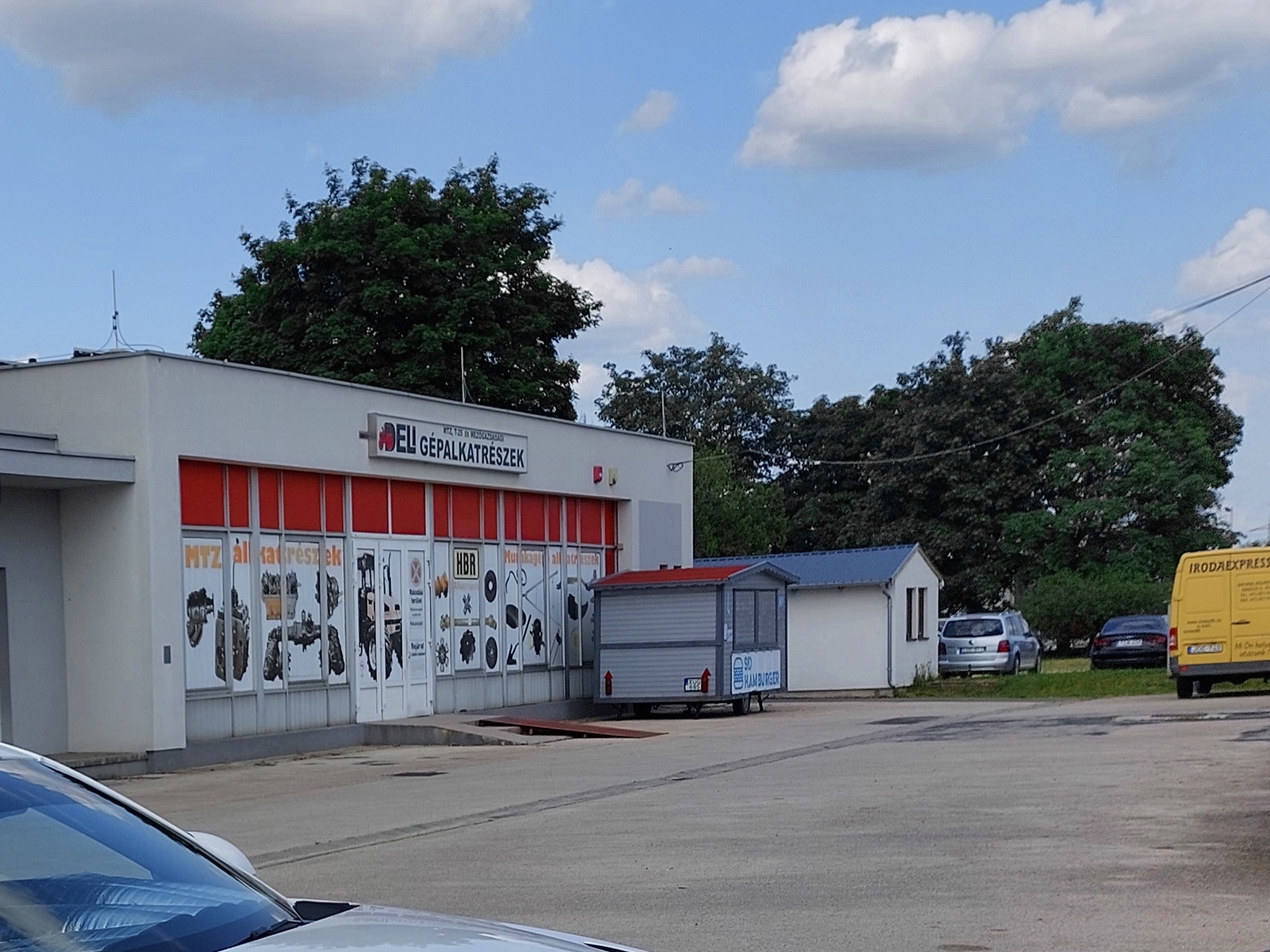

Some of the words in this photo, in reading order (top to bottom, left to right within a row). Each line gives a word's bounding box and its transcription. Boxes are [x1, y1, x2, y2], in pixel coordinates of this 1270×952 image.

[420, 433, 525, 468] GÉPALKATRÉSZEK
[185, 544, 222, 569] MTZ
[456, 552, 476, 576] HBR
[744, 671, 780, 689] HAMBURGER
